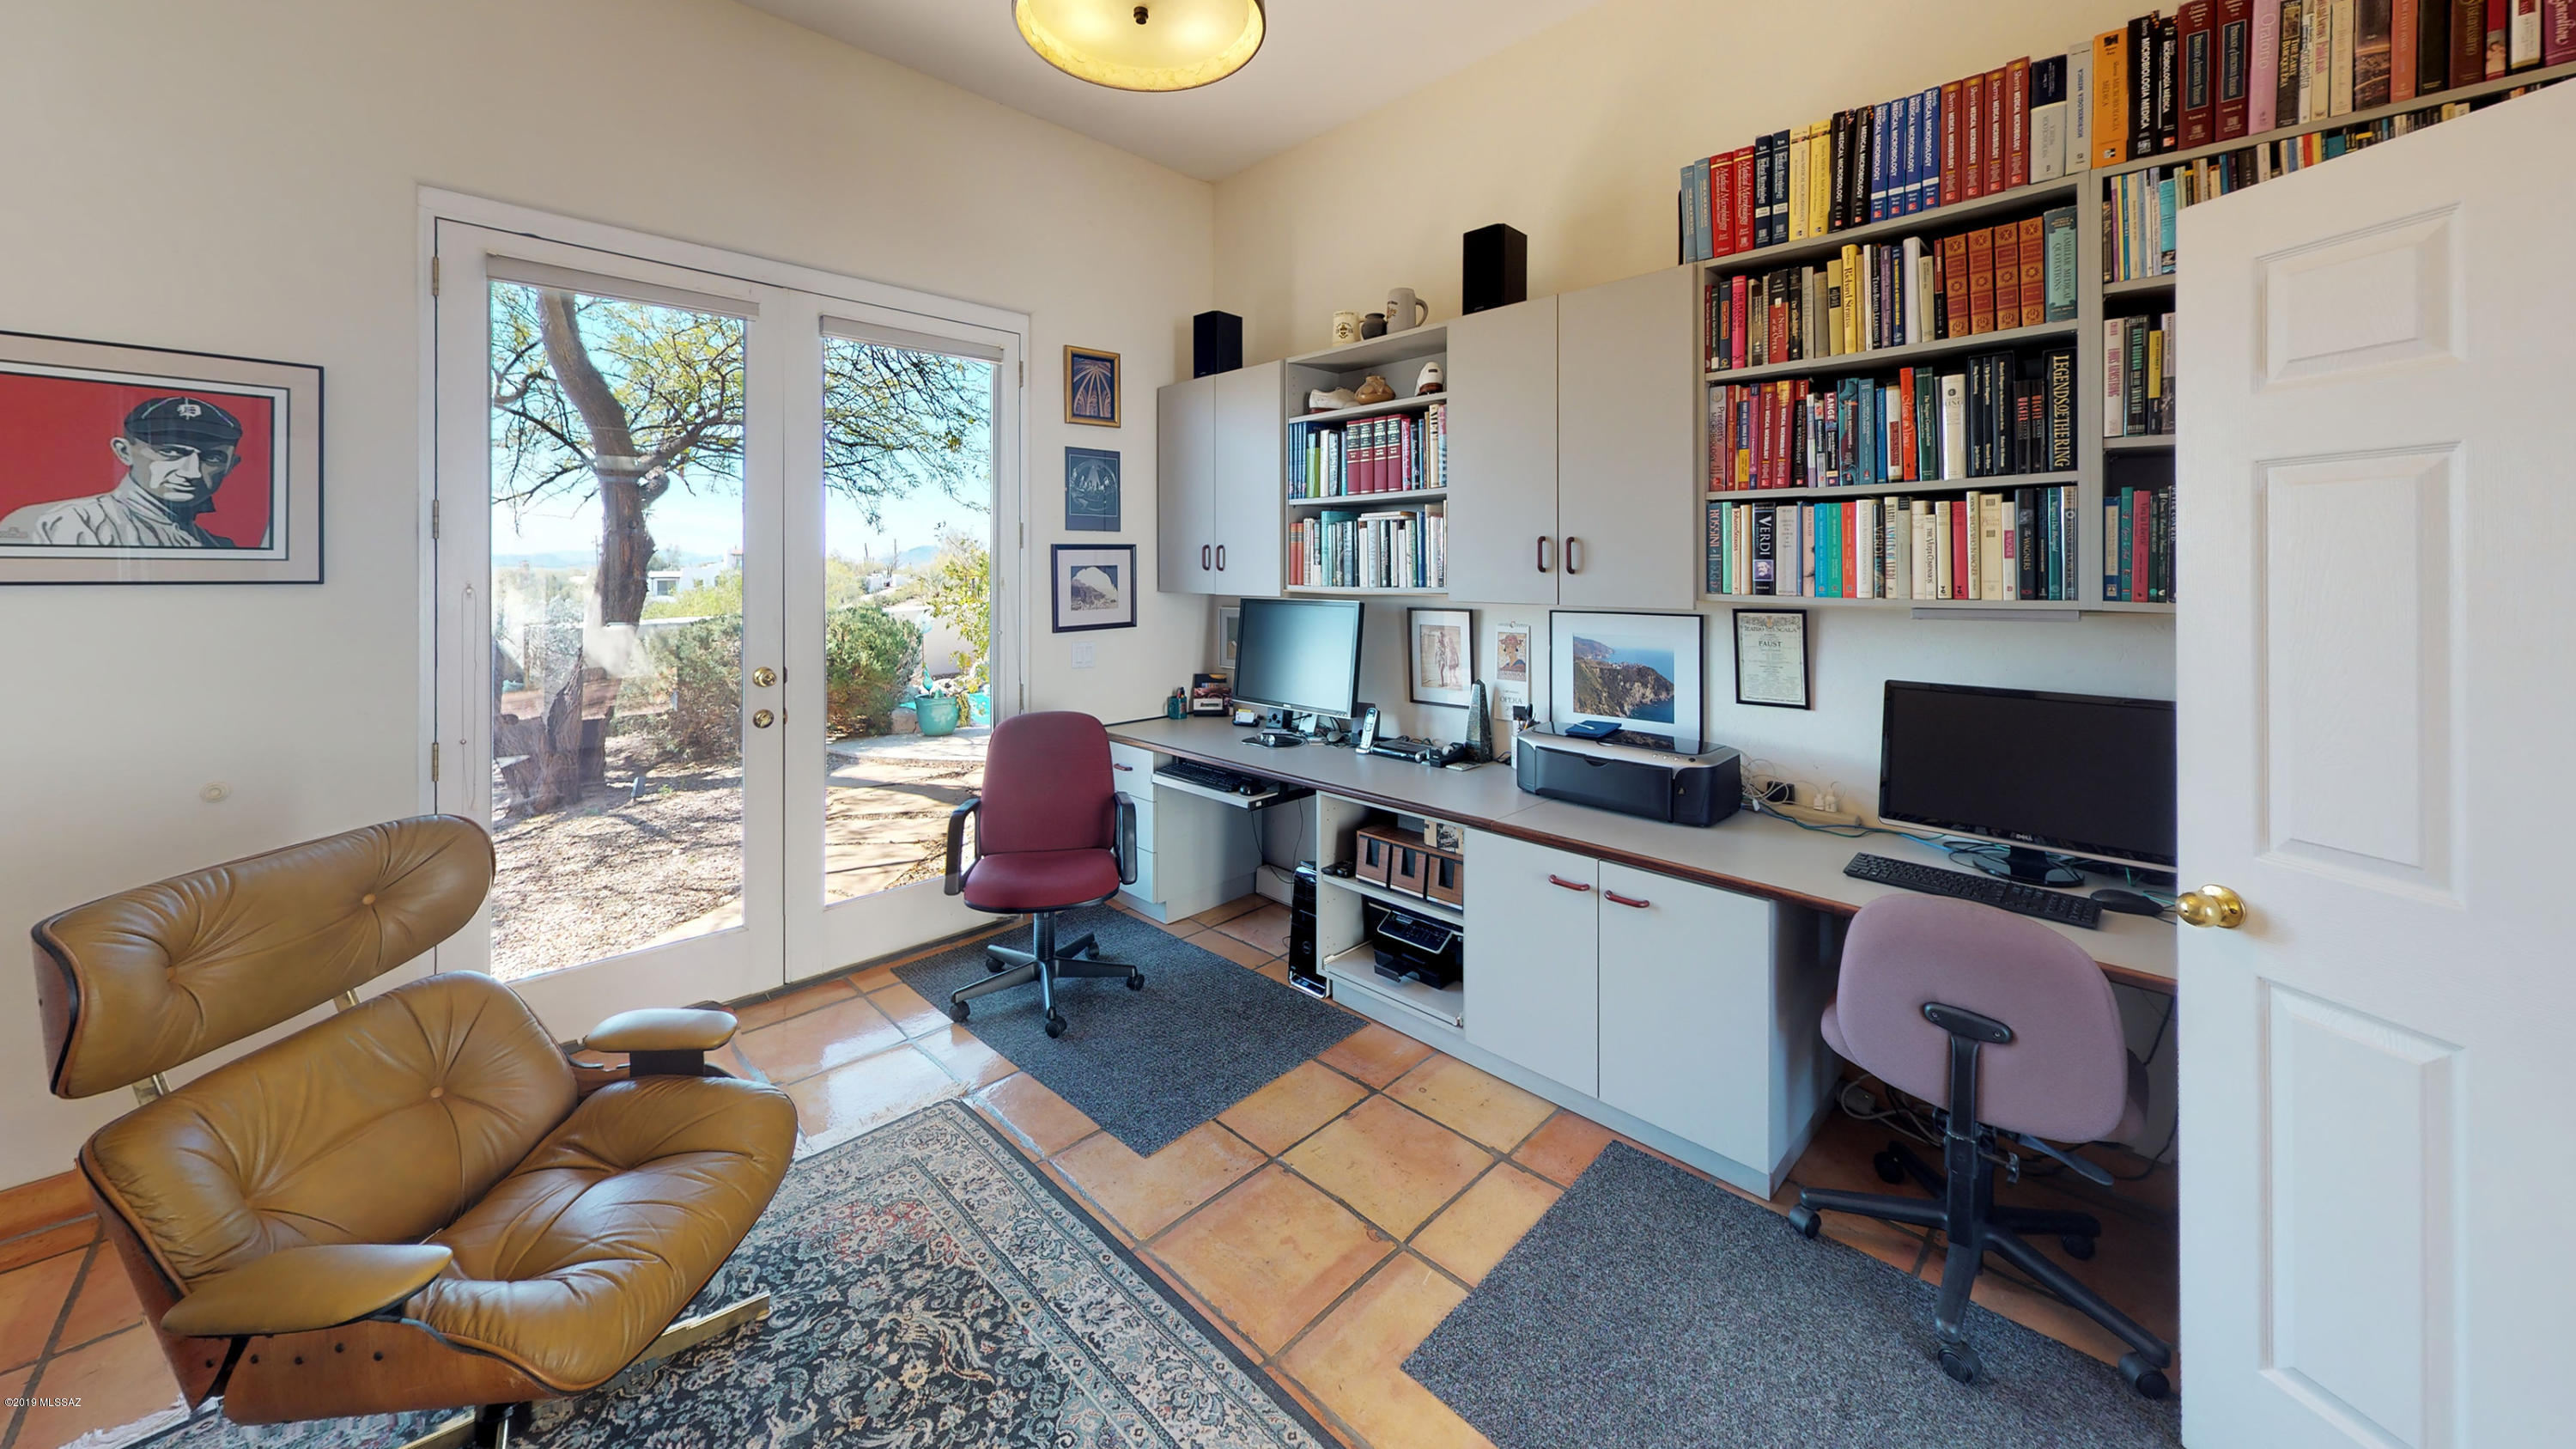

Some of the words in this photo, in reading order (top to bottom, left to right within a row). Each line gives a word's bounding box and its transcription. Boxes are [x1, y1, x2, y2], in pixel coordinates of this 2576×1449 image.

[2259, 13, 2275, 70] Oratorio
[2291, 38, 2300, 55] THE
[2280, 40, 2291, 74] BAROQUE
[2300, 50, 2310, 89] orchestra
[1859, 125, 1868, 152] MEDICAL
[1991, 123, 2000, 158] MICROBIOLOGY
[1720, 167, 1728, 192] Medical
[1741, 161, 1751, 186] Medical
[1856, 153, 1866, 198] MICROBIOLOGY
[2063, 232, 2071, 265] FAMILIAR
[2052, 243, 2062, 291] QUOTATIONS
[1844, 267, 1852, 298] Richard
[2063, 268, 2071, 300] MEDICAL
[2107, 348, 2121, 364] LOUIS
[2053, 355, 2069, 405] LEGENDS
[2107, 365, 2120, 398] ARMSTRONG
[1826, 393, 1835, 420] LANGE
[2017, 397, 2028, 422] WAGNER
[2032, 395, 2043, 420] WAGNER
[2054, 405, 2069, 417] OF
[2054, 417, 2069, 438] THE
[2054, 438, 2070, 466] RING
[1710, 508, 1720, 548] ROSSINI
[1759, 516, 1771, 555] VERDI
[1874, 525, 1883, 557] VERDI
[1886, 527, 1895, 551] ASPECTS
[1886, 562, 1896, 580] VERDI
[1500, 696, 1522, 704] OPERA
[2015, 833, 2033, 842] DELL
